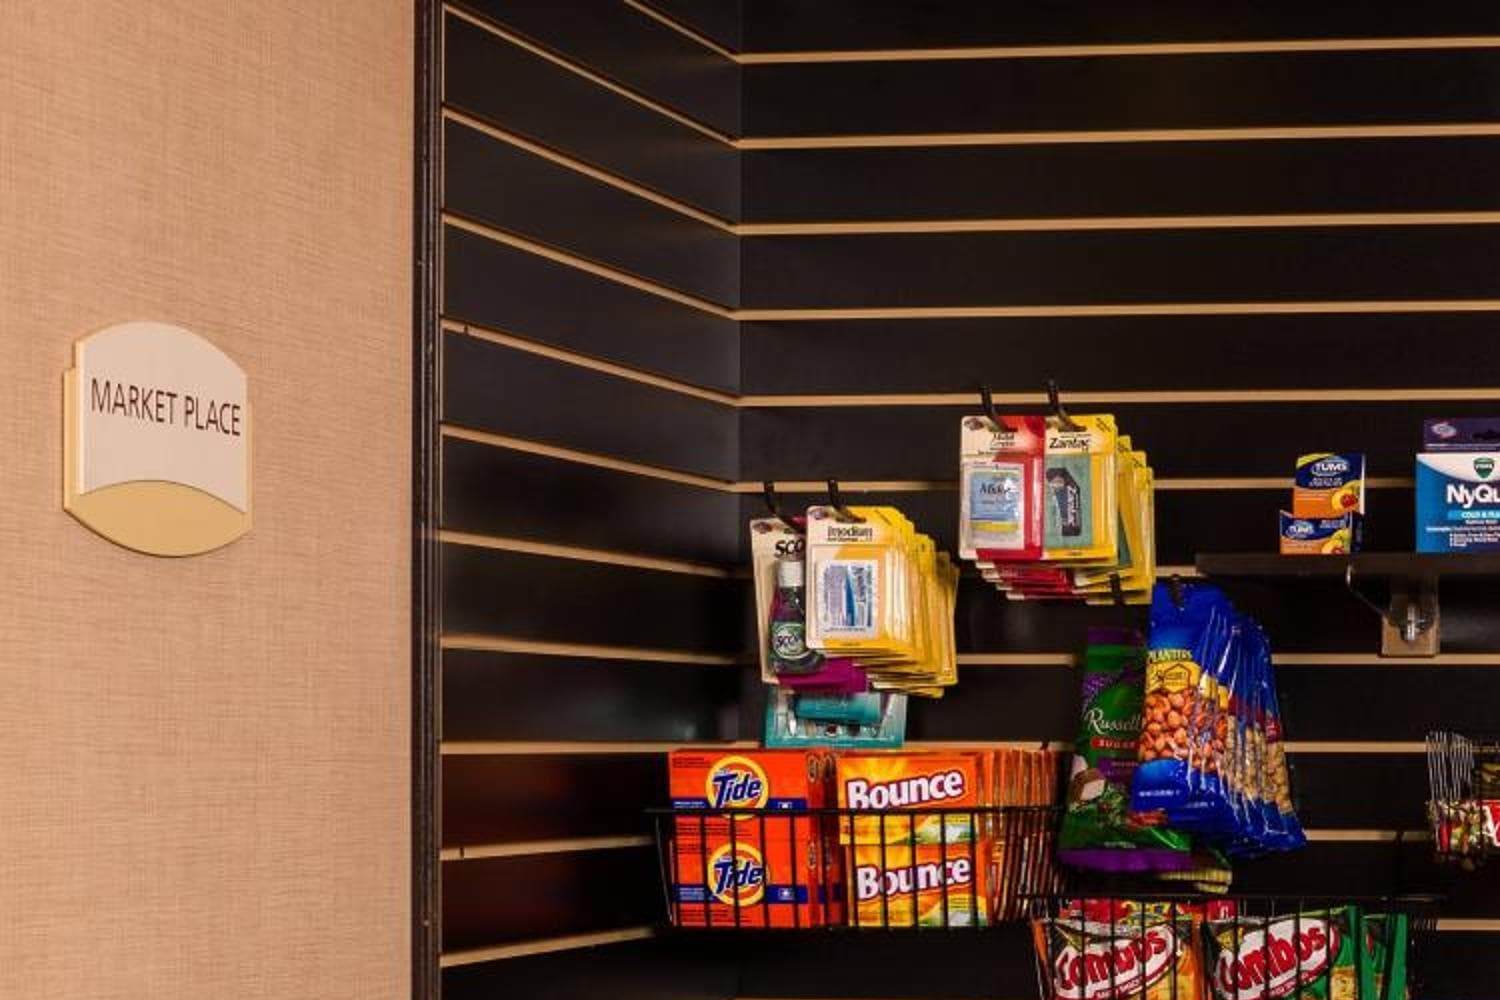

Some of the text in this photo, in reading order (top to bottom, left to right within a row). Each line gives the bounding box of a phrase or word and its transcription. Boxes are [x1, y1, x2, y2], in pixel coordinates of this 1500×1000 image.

[91, 377, 241, 436] MARKET PLACE
[1050, 437, 1090, 449] Zantac
[1314, 462, 1347, 472] TUMS
[713, 773, 762, 808] Tide
[847, 771, 963, 809] Bounce
[714, 860, 763, 894] Tide
[857, 858, 970, 899] Bounce
